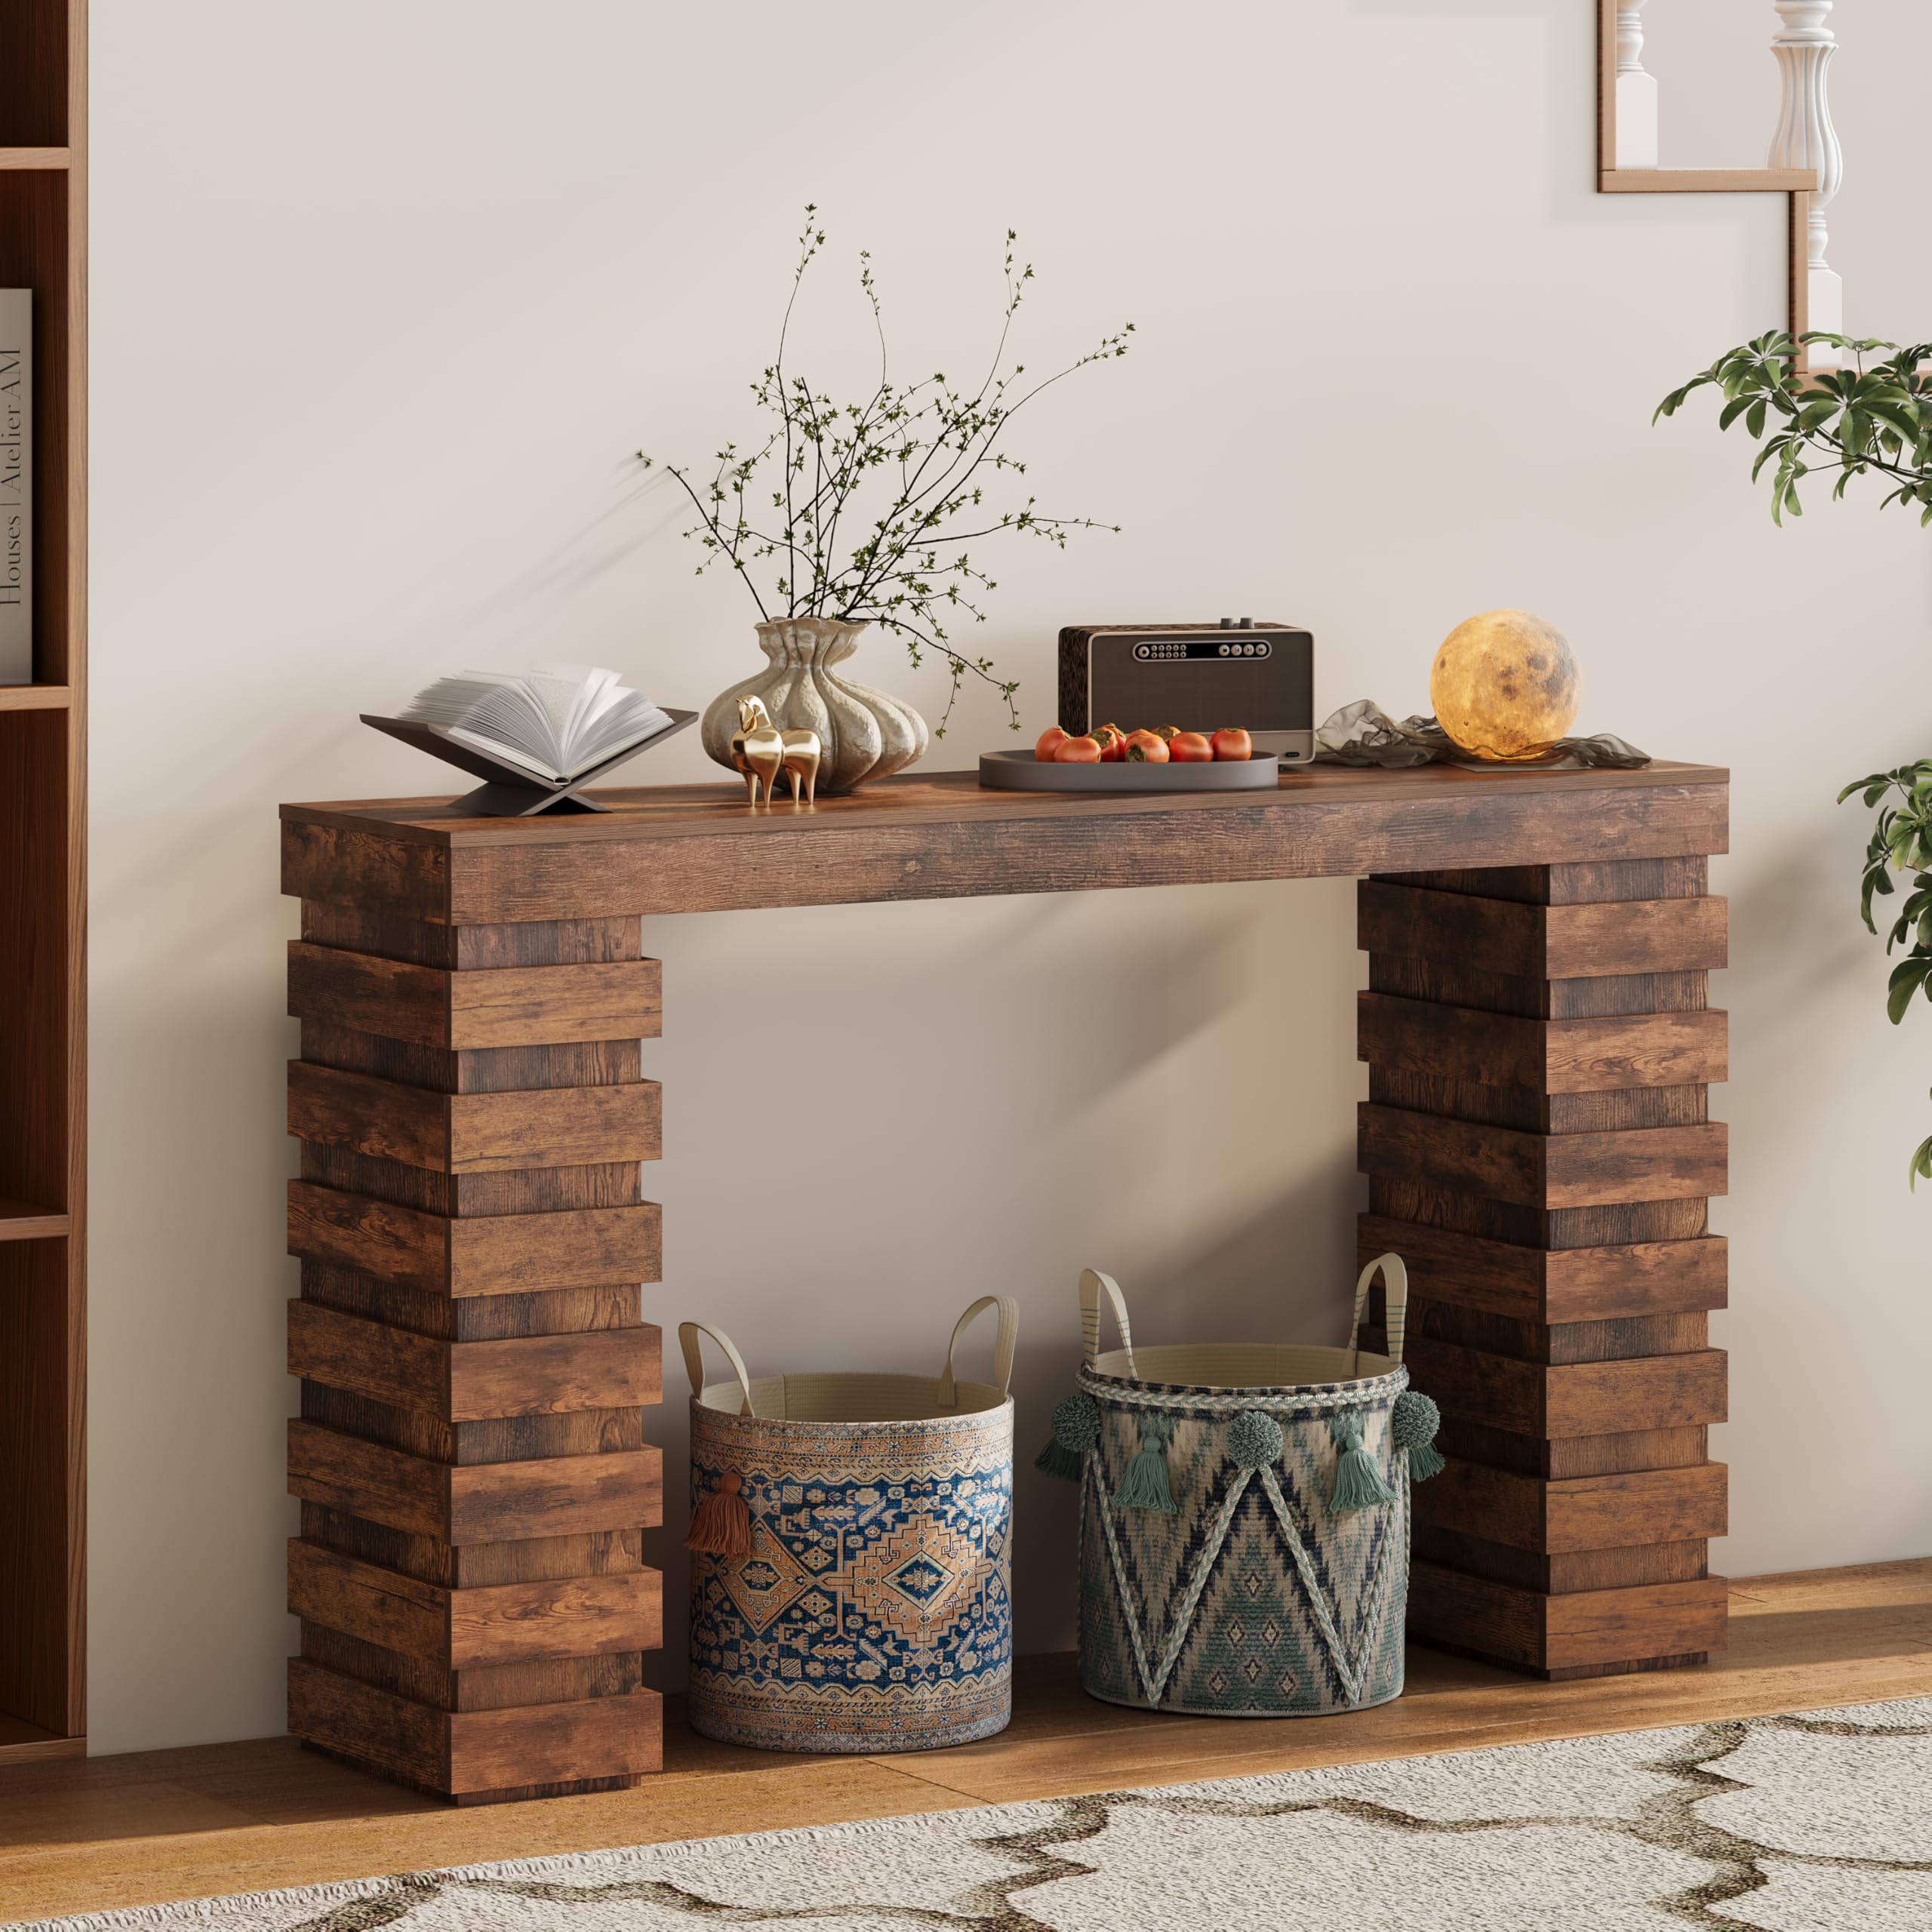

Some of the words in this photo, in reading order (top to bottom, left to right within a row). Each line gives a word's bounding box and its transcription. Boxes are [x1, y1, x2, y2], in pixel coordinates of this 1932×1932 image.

[0, 349, 21, 399] AM
[0, 404, 20, 493] Atelier
[0, 515, 20, 605] Houses
